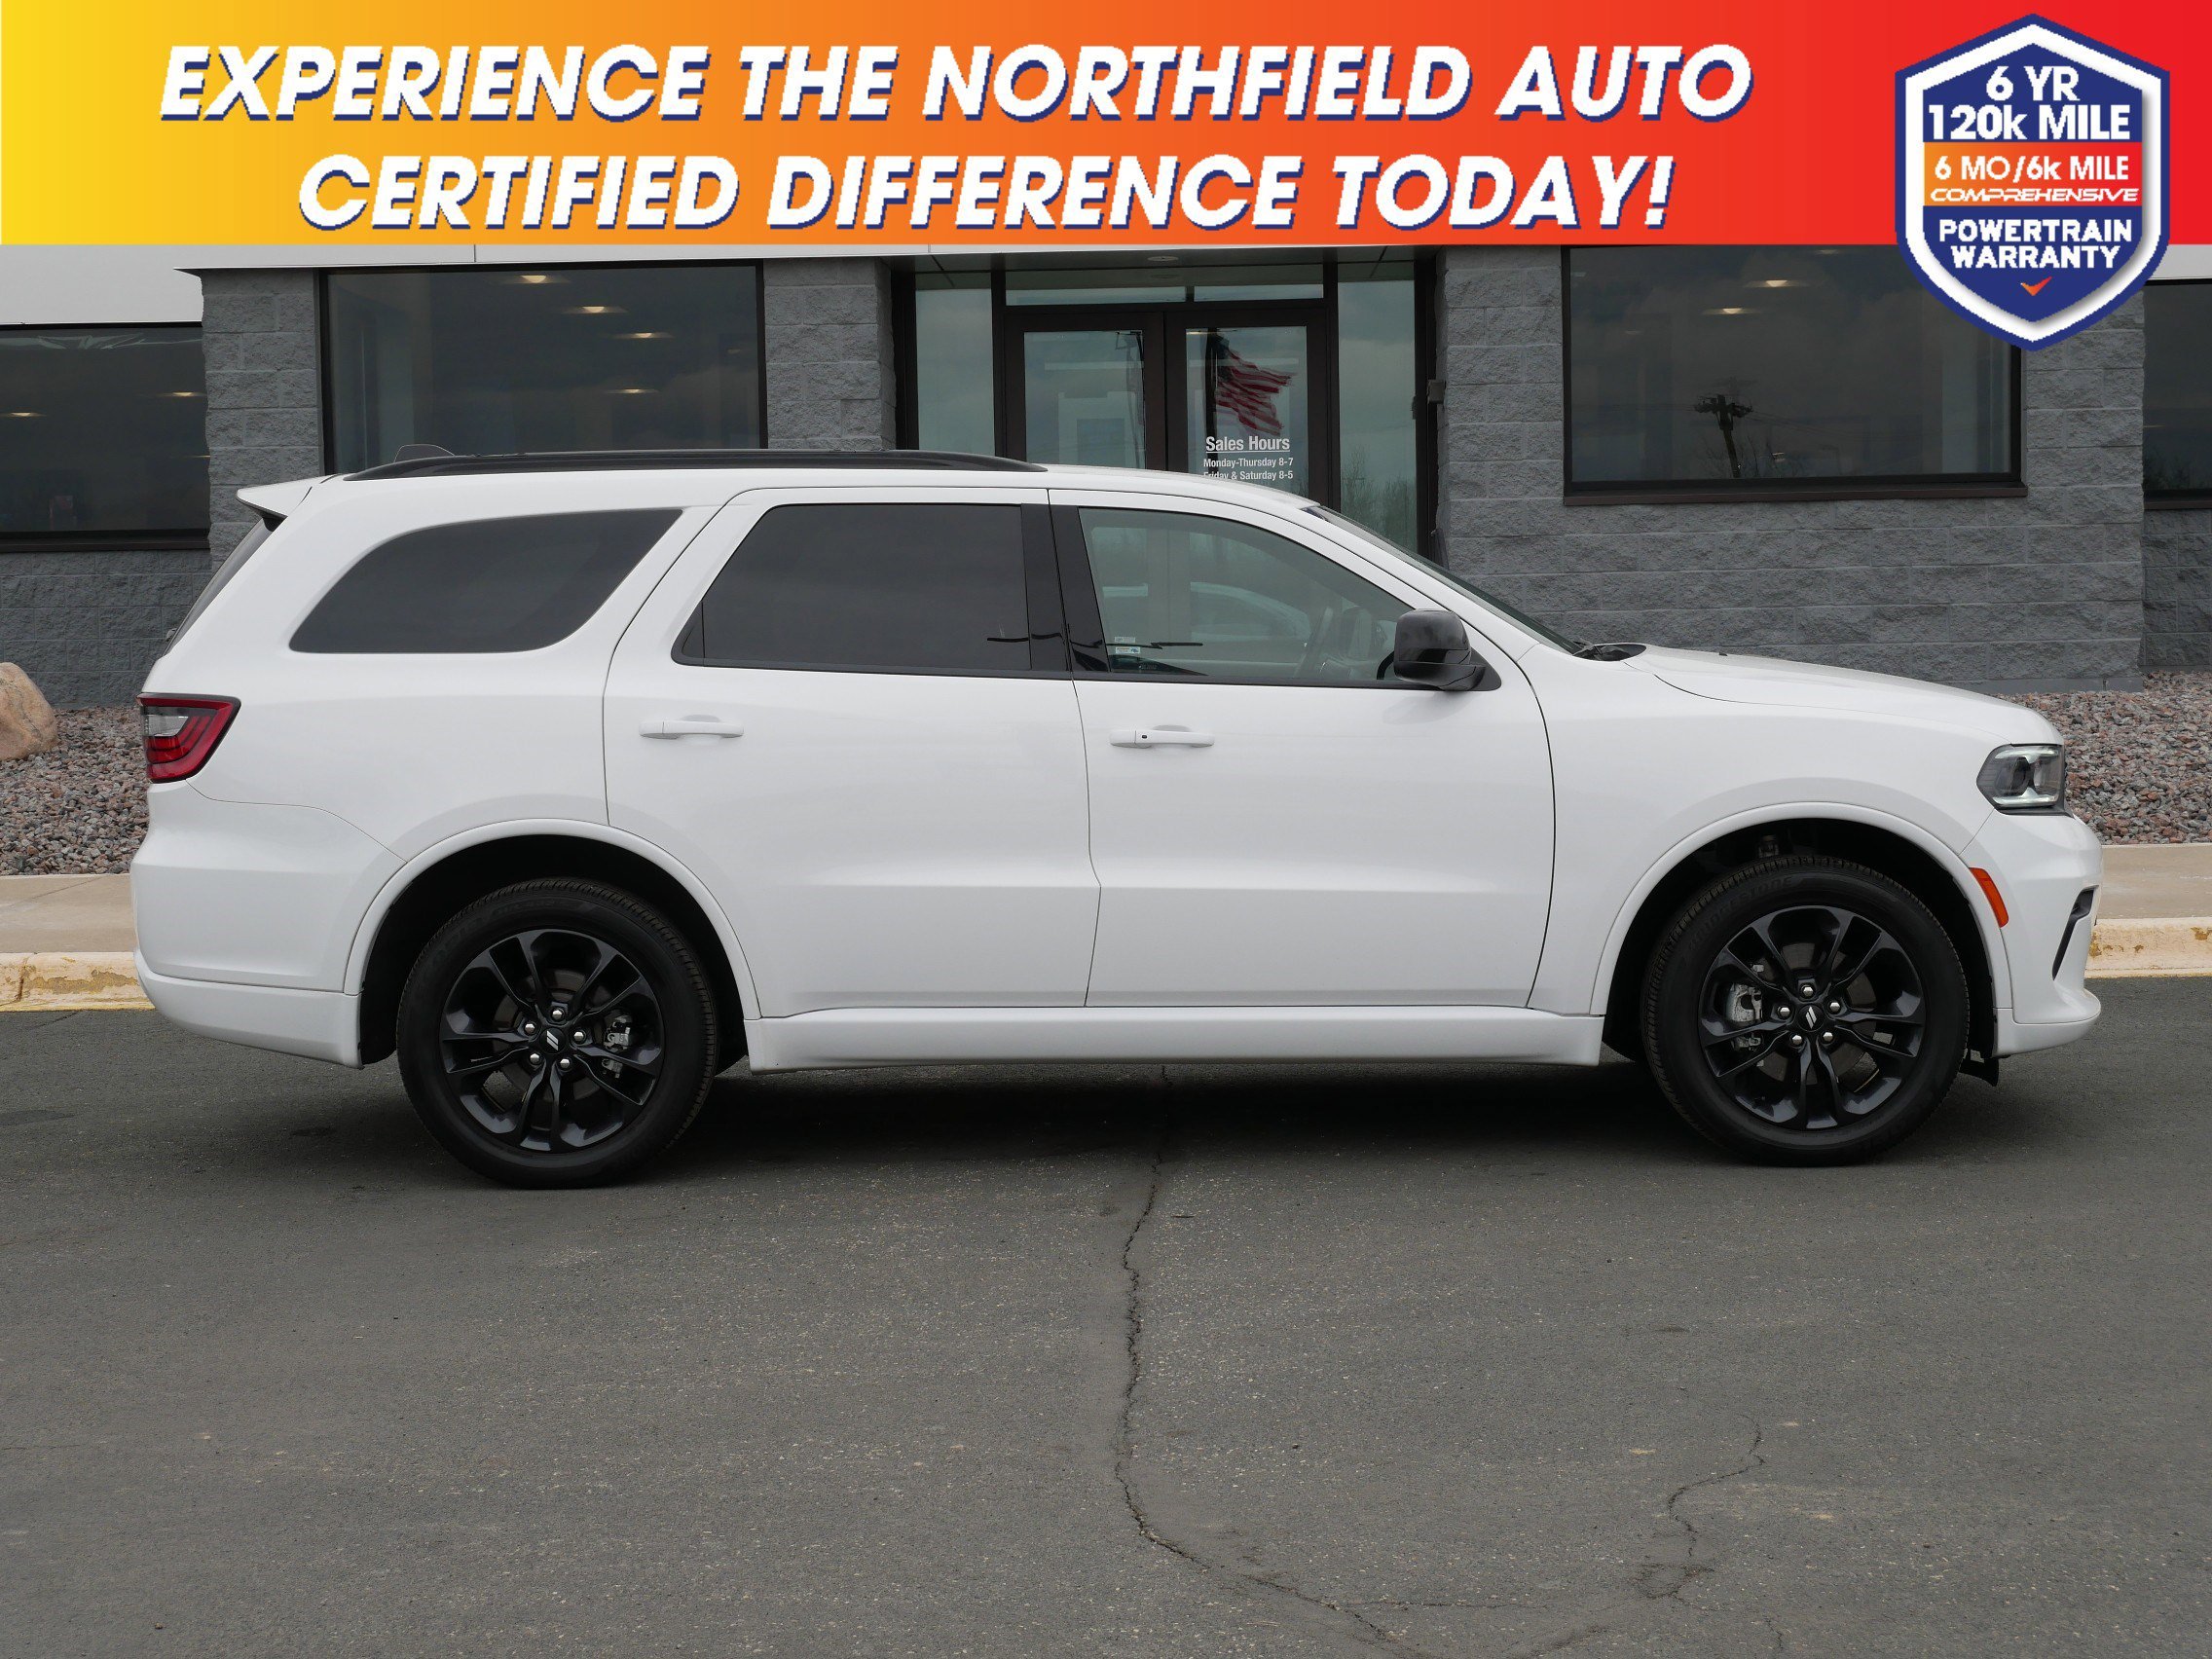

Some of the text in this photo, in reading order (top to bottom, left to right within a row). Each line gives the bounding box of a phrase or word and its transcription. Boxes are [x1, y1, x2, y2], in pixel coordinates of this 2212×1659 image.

[1205, 435, 1290, 452] Sales Hours
[1203, 458, 1276, 468] Monday-Thursday
[1231, 471, 1237, 480] &
[1239, 471, 1276, 481] Saturday
[1278, 470, 1294, 480] 8-5
